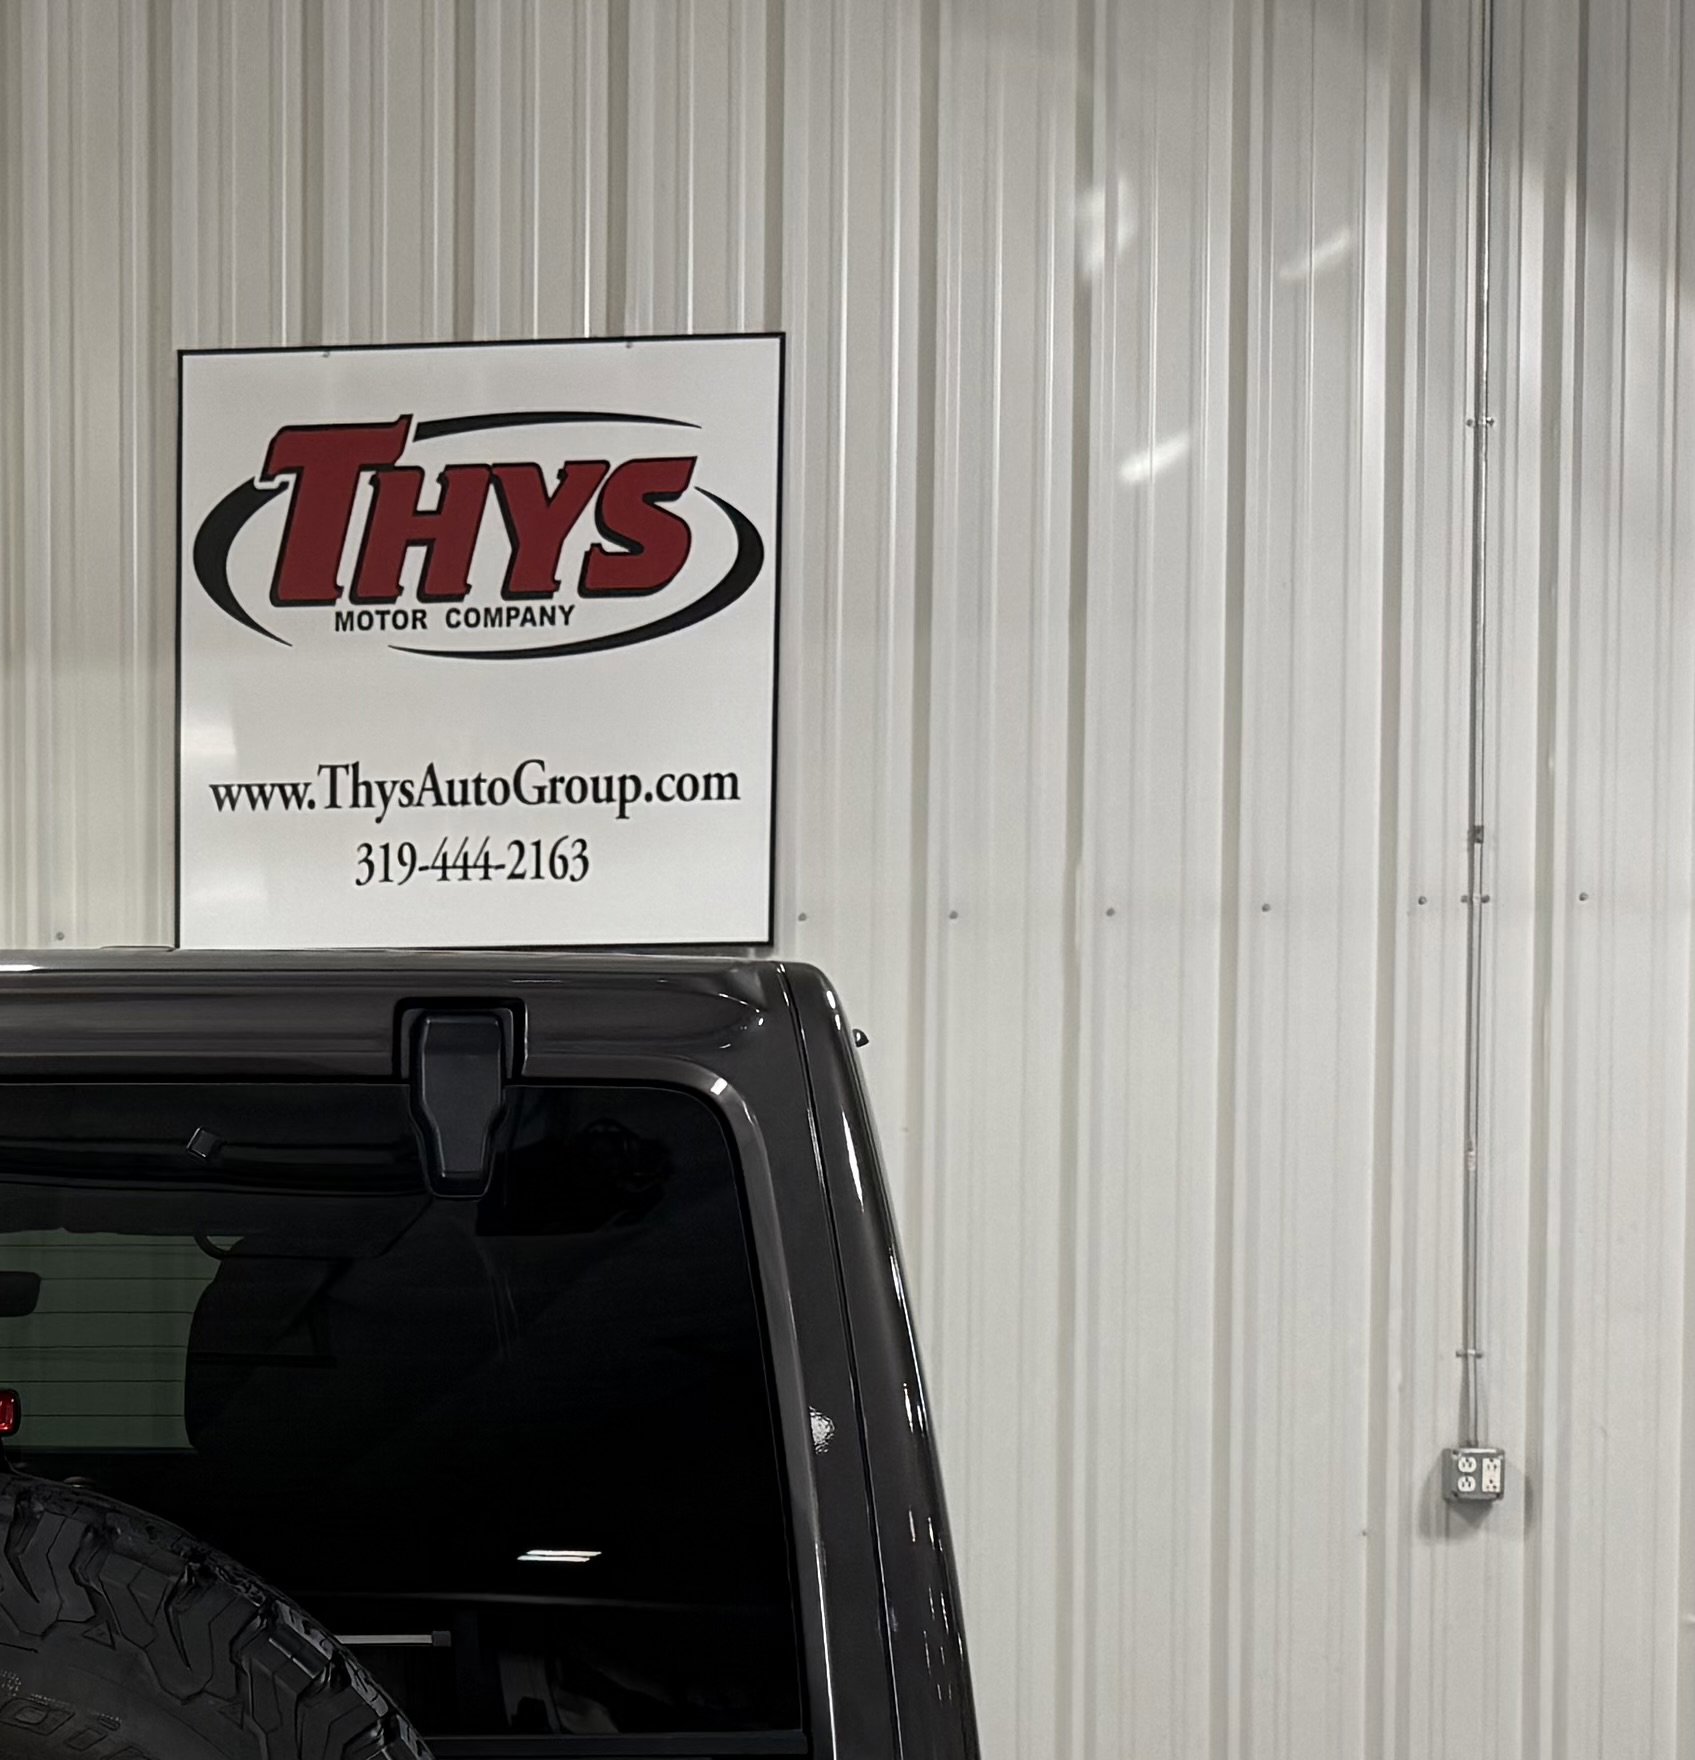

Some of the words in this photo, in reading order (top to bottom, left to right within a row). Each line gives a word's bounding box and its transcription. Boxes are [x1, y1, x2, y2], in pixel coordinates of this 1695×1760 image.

[334, 607, 428, 632] MOTOR
[445, 604, 576, 629] COMPANY
[209, 759, 741, 824] www.ThysAutoGroup.com
[354, 836, 591, 886] 319-444-2163
